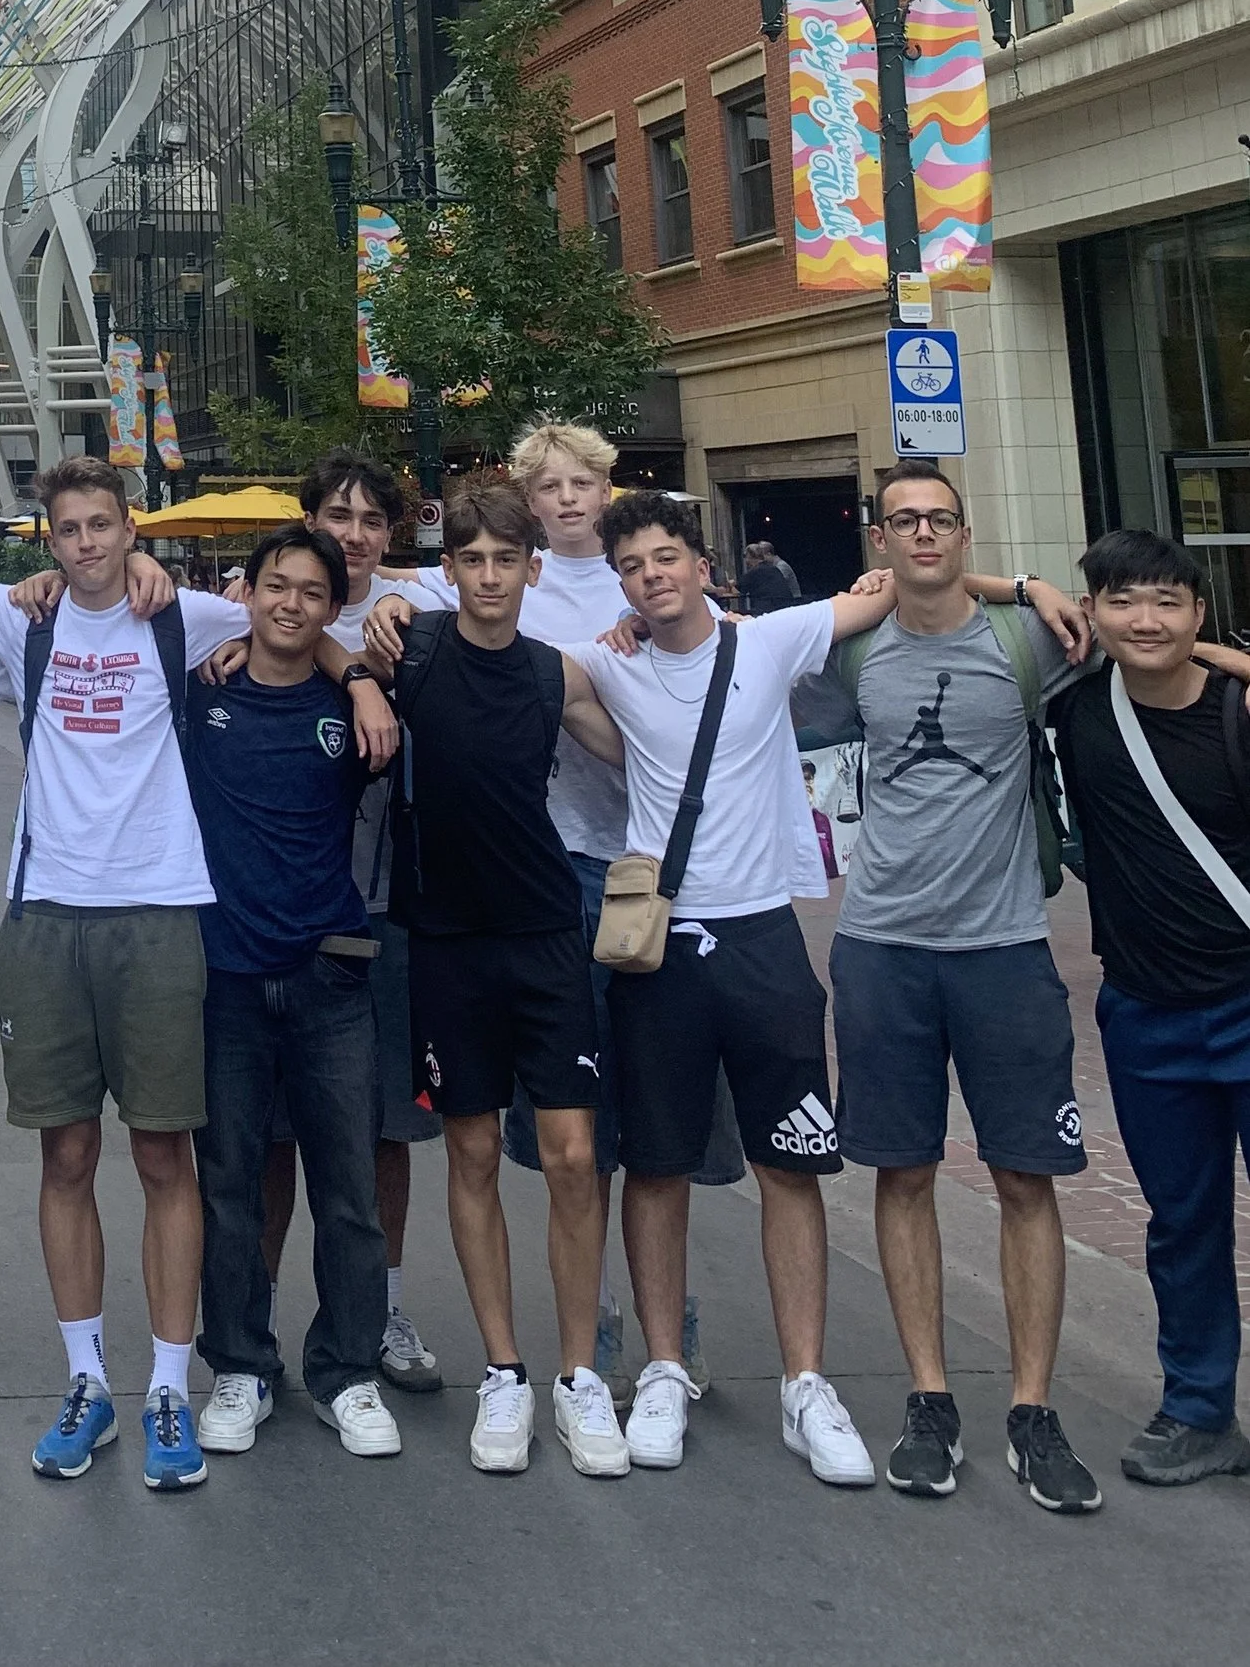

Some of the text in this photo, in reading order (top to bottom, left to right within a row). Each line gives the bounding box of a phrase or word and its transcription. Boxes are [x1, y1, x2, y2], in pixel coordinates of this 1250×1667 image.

[803, 19, 860, 196] Stephen Avenue
[811, 154, 859, 237] Walk
[897, 409, 959, 423] 06:00-18:00
[56, 654, 78, 666] YOUTH
